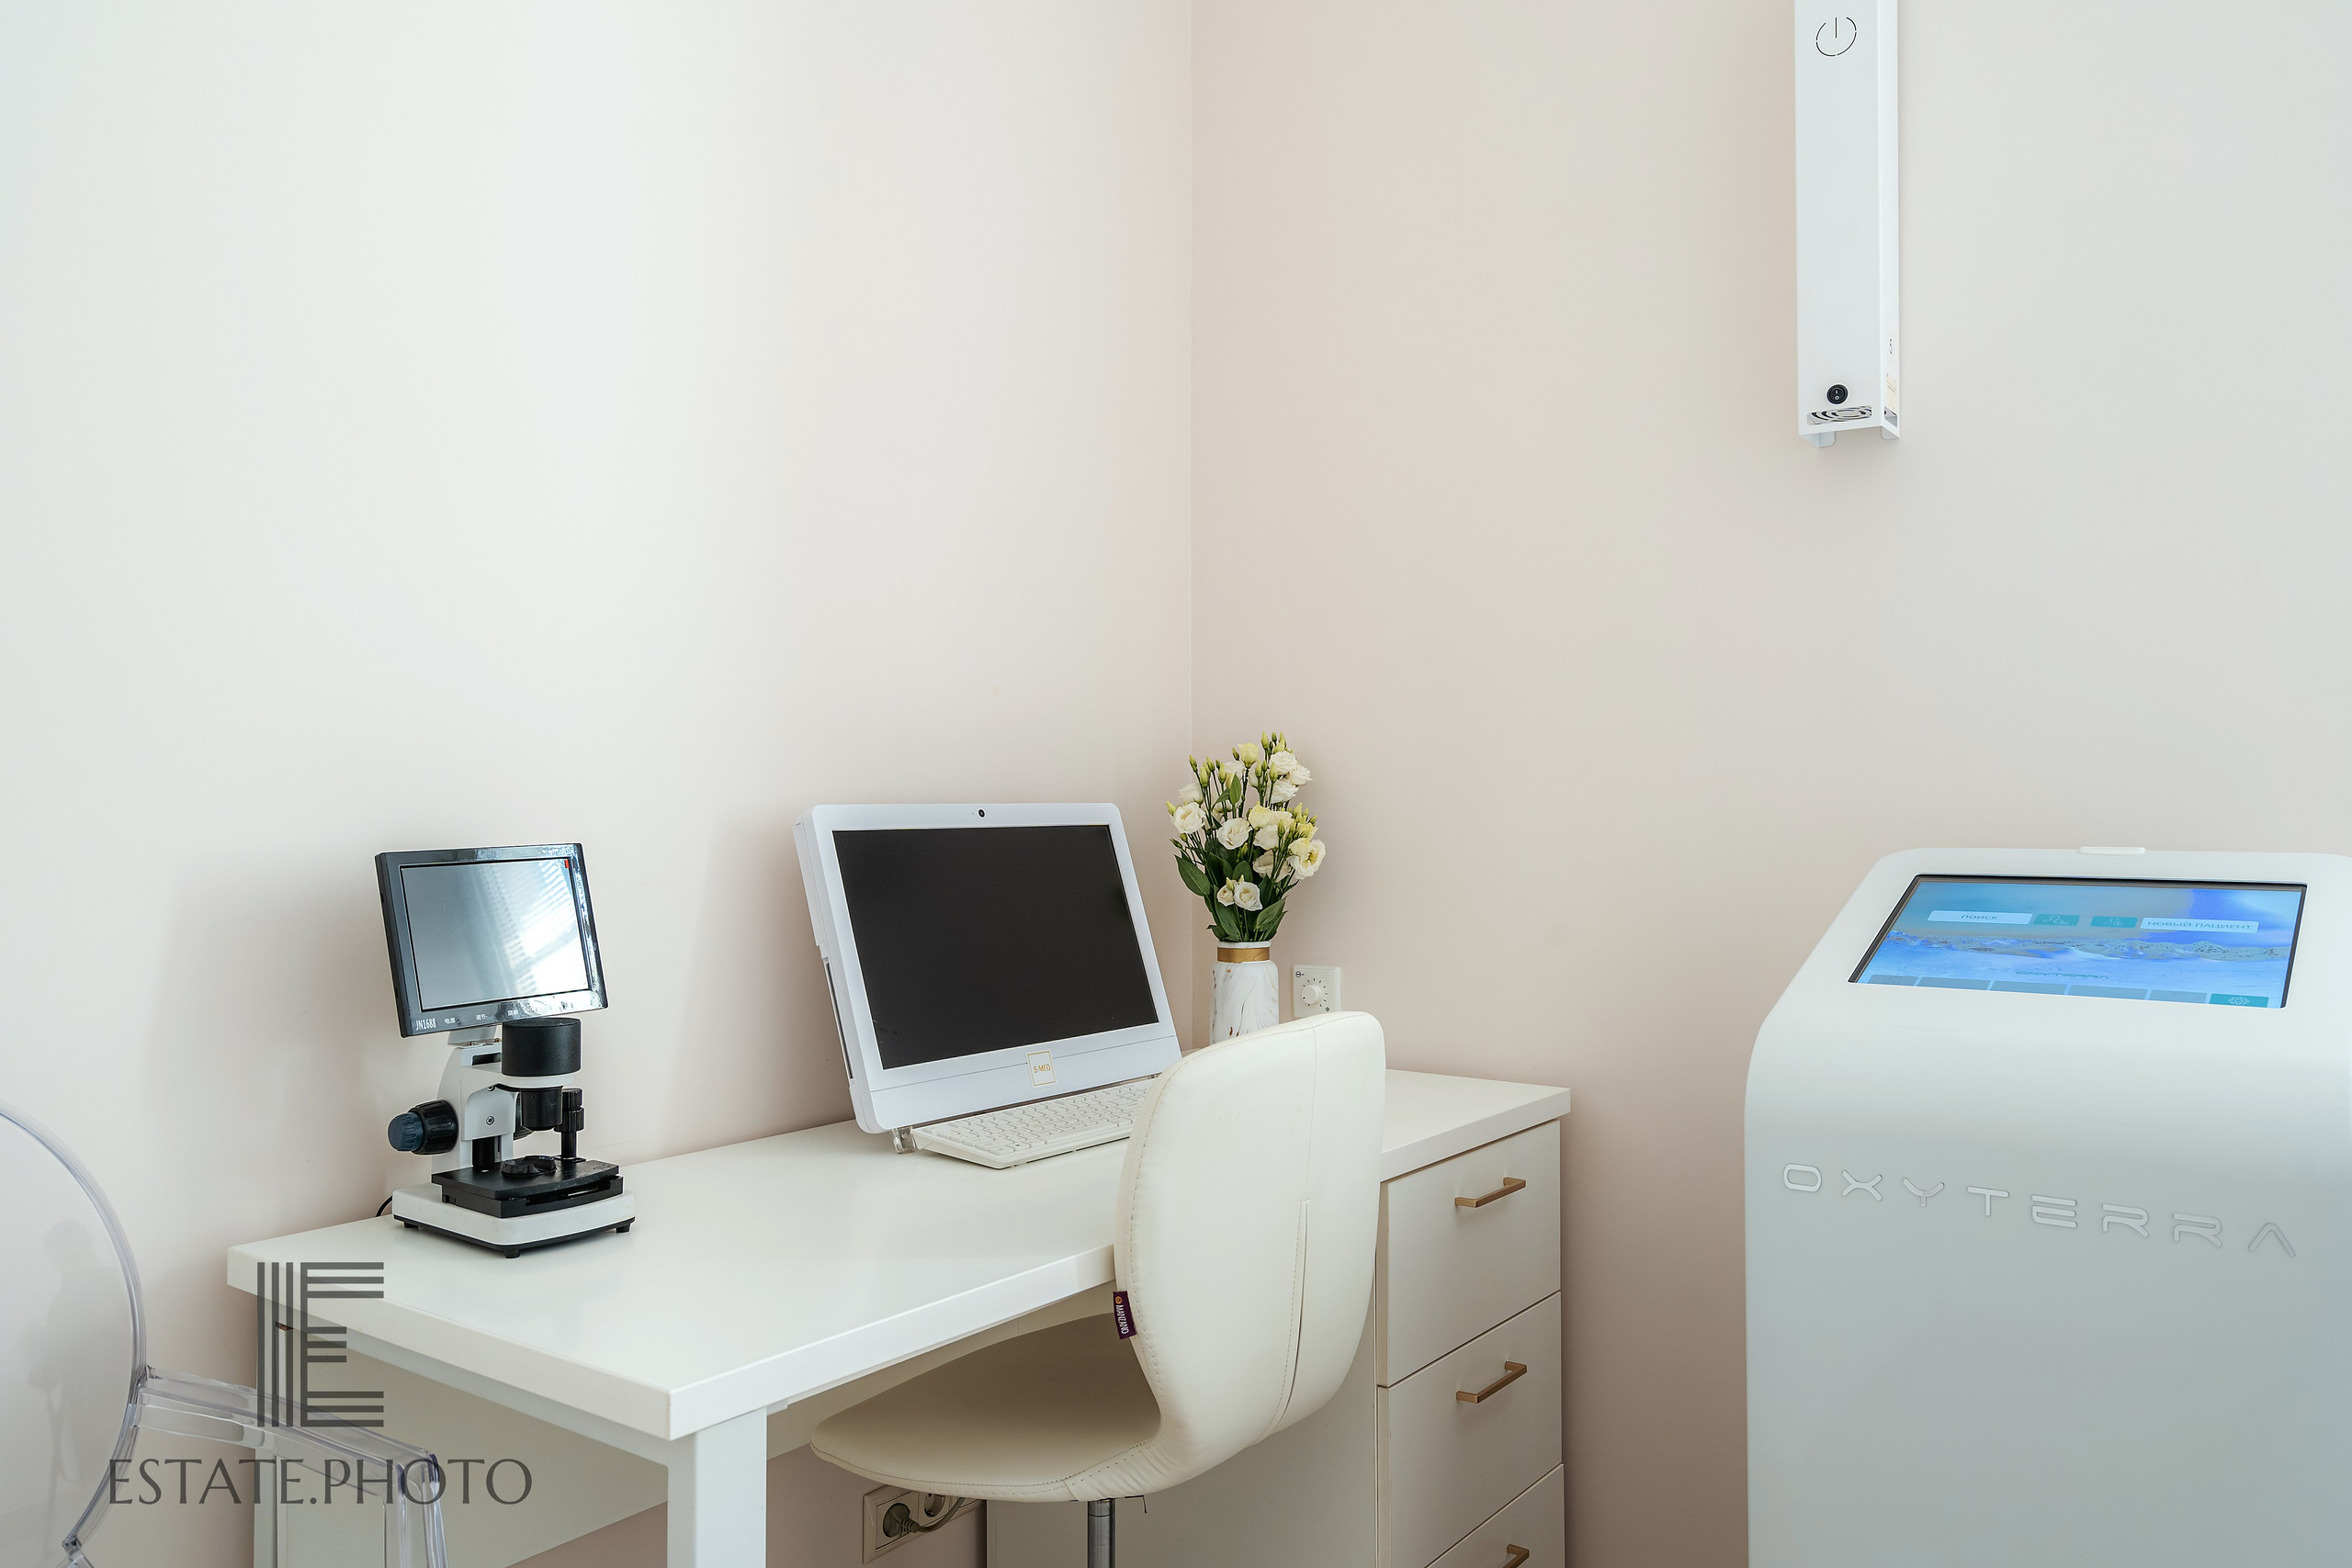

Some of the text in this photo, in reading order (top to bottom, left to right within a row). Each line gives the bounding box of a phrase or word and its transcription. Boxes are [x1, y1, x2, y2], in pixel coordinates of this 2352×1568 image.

[415, 1018, 436, 1031] JN1688
[1783, 1162, 2296, 1258] OXYTERRA
[1115, 1304, 1130, 1335] MANZANO
